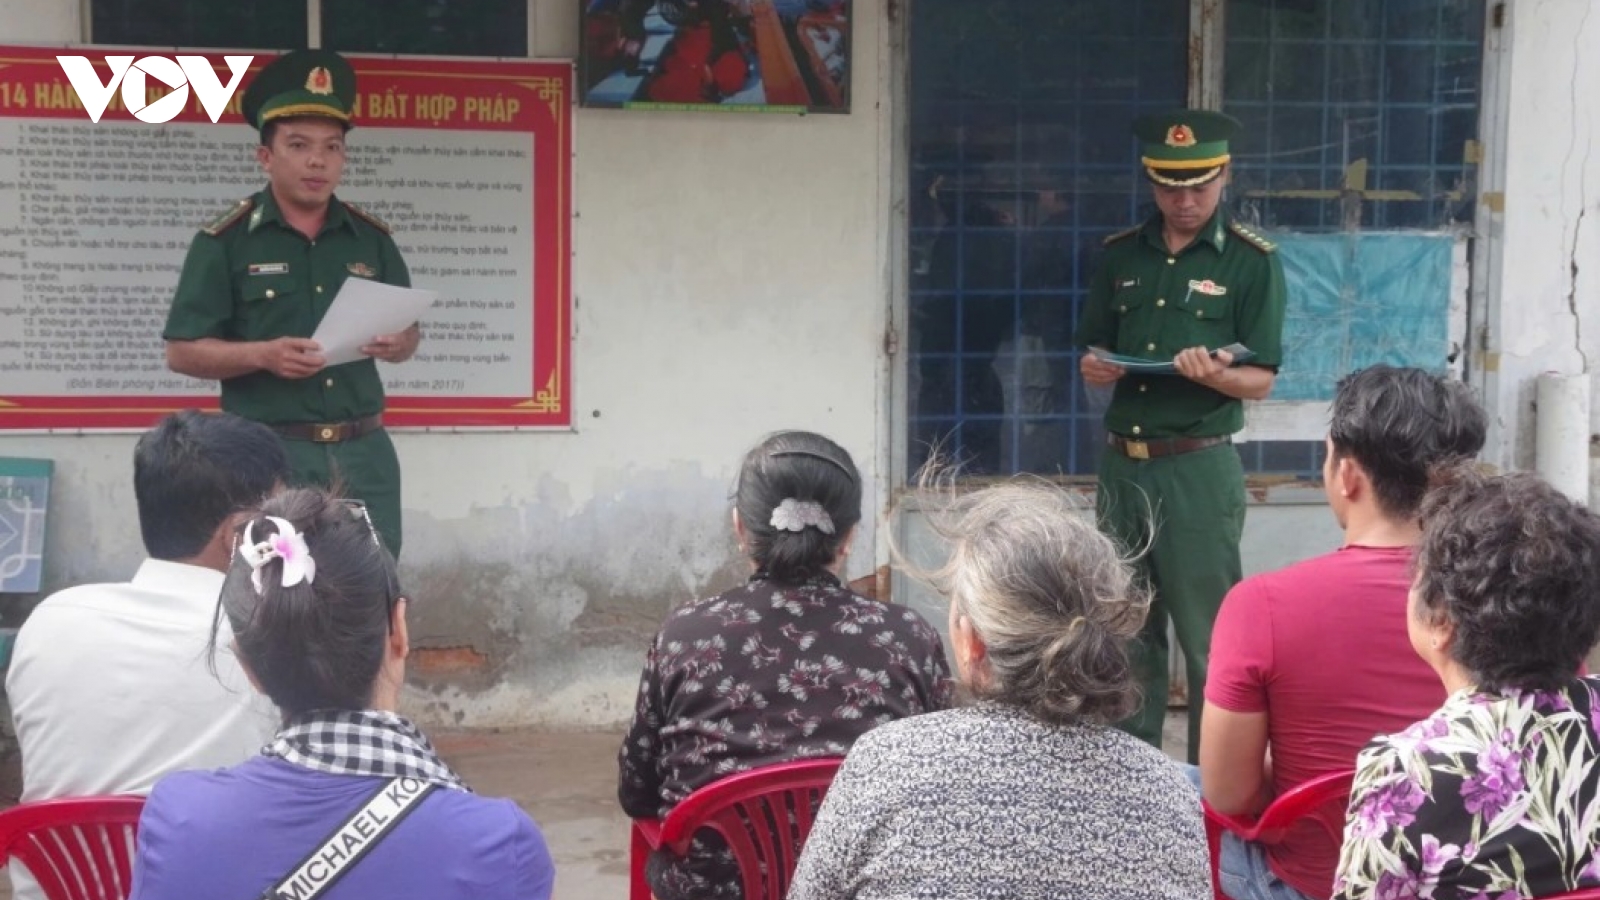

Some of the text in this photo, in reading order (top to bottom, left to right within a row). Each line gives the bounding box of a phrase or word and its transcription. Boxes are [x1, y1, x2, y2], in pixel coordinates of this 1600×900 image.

[0, 82, 28, 109] 14
[369, 86, 409, 119] BẤT
[416, 94, 456, 126] HỢP
[464, 93, 520, 123] PHÁP
[279, 777, 427, 900] MICHAEL KO
